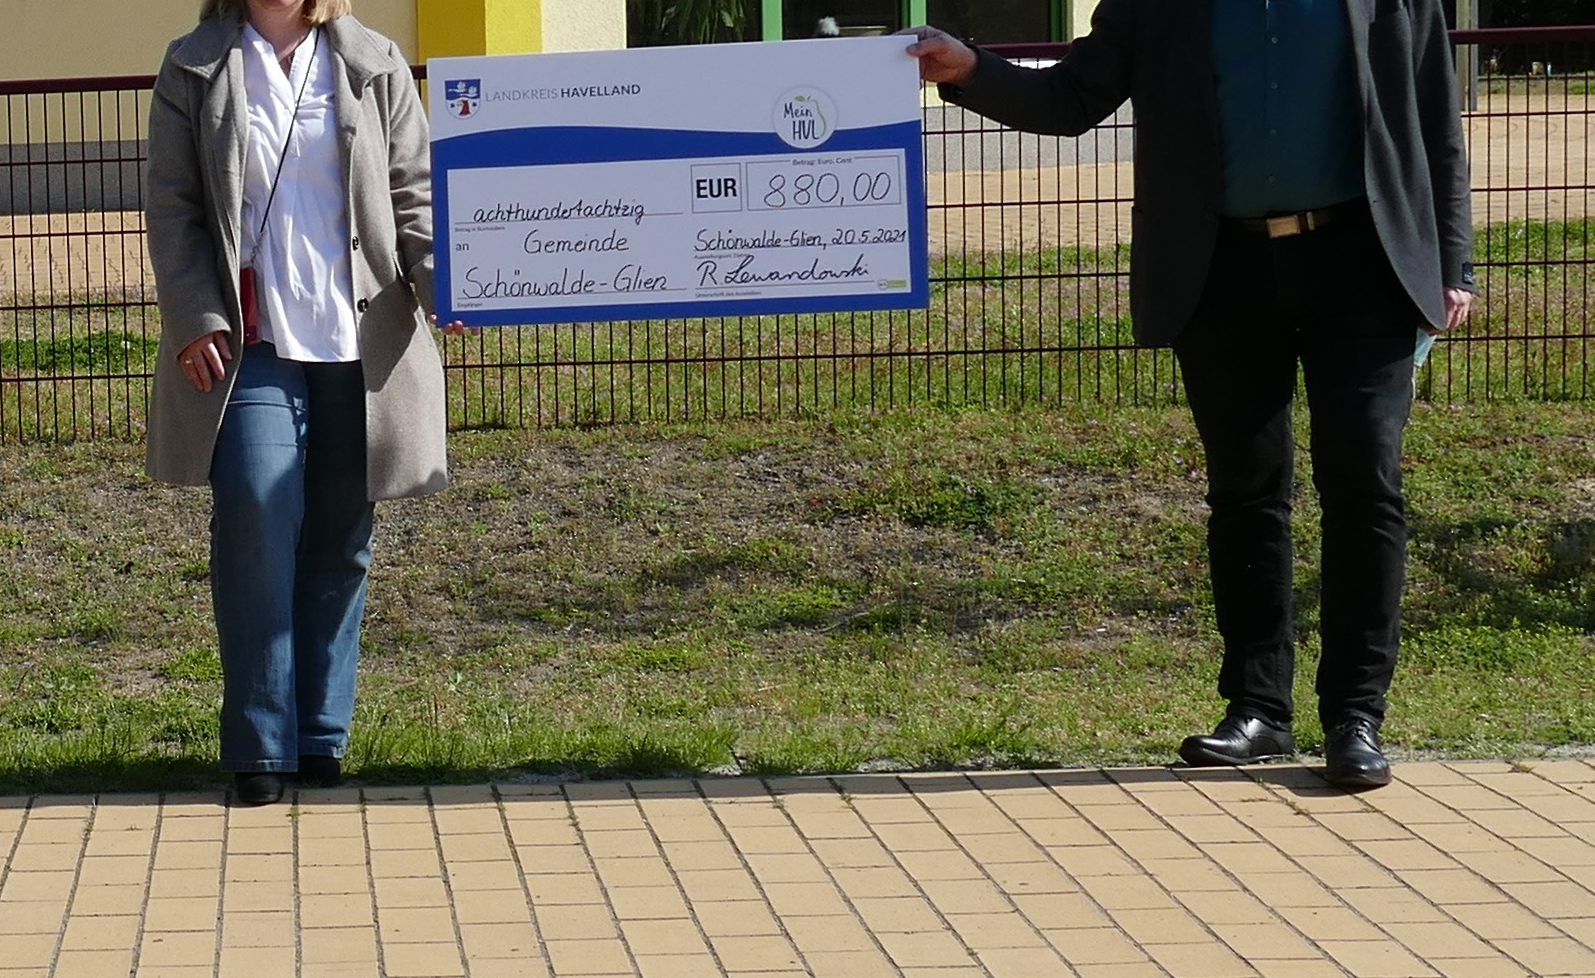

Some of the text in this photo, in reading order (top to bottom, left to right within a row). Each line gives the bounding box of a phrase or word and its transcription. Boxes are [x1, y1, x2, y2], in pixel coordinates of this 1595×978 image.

[485, 84, 641, 102] LANDKREIS HAVELLAND
[783, 102, 813, 119] Mein
[793, 120, 821, 140] HVL
[695, 177, 737, 199] EUR
[764, 172, 891, 208] 880,00
[473, 198, 645, 225] achthundertachtzig
[456, 242, 470, 251] an
[524, 228, 630, 254] Gemeinde
[462, 264, 668, 299] Schönwalde-Glien
